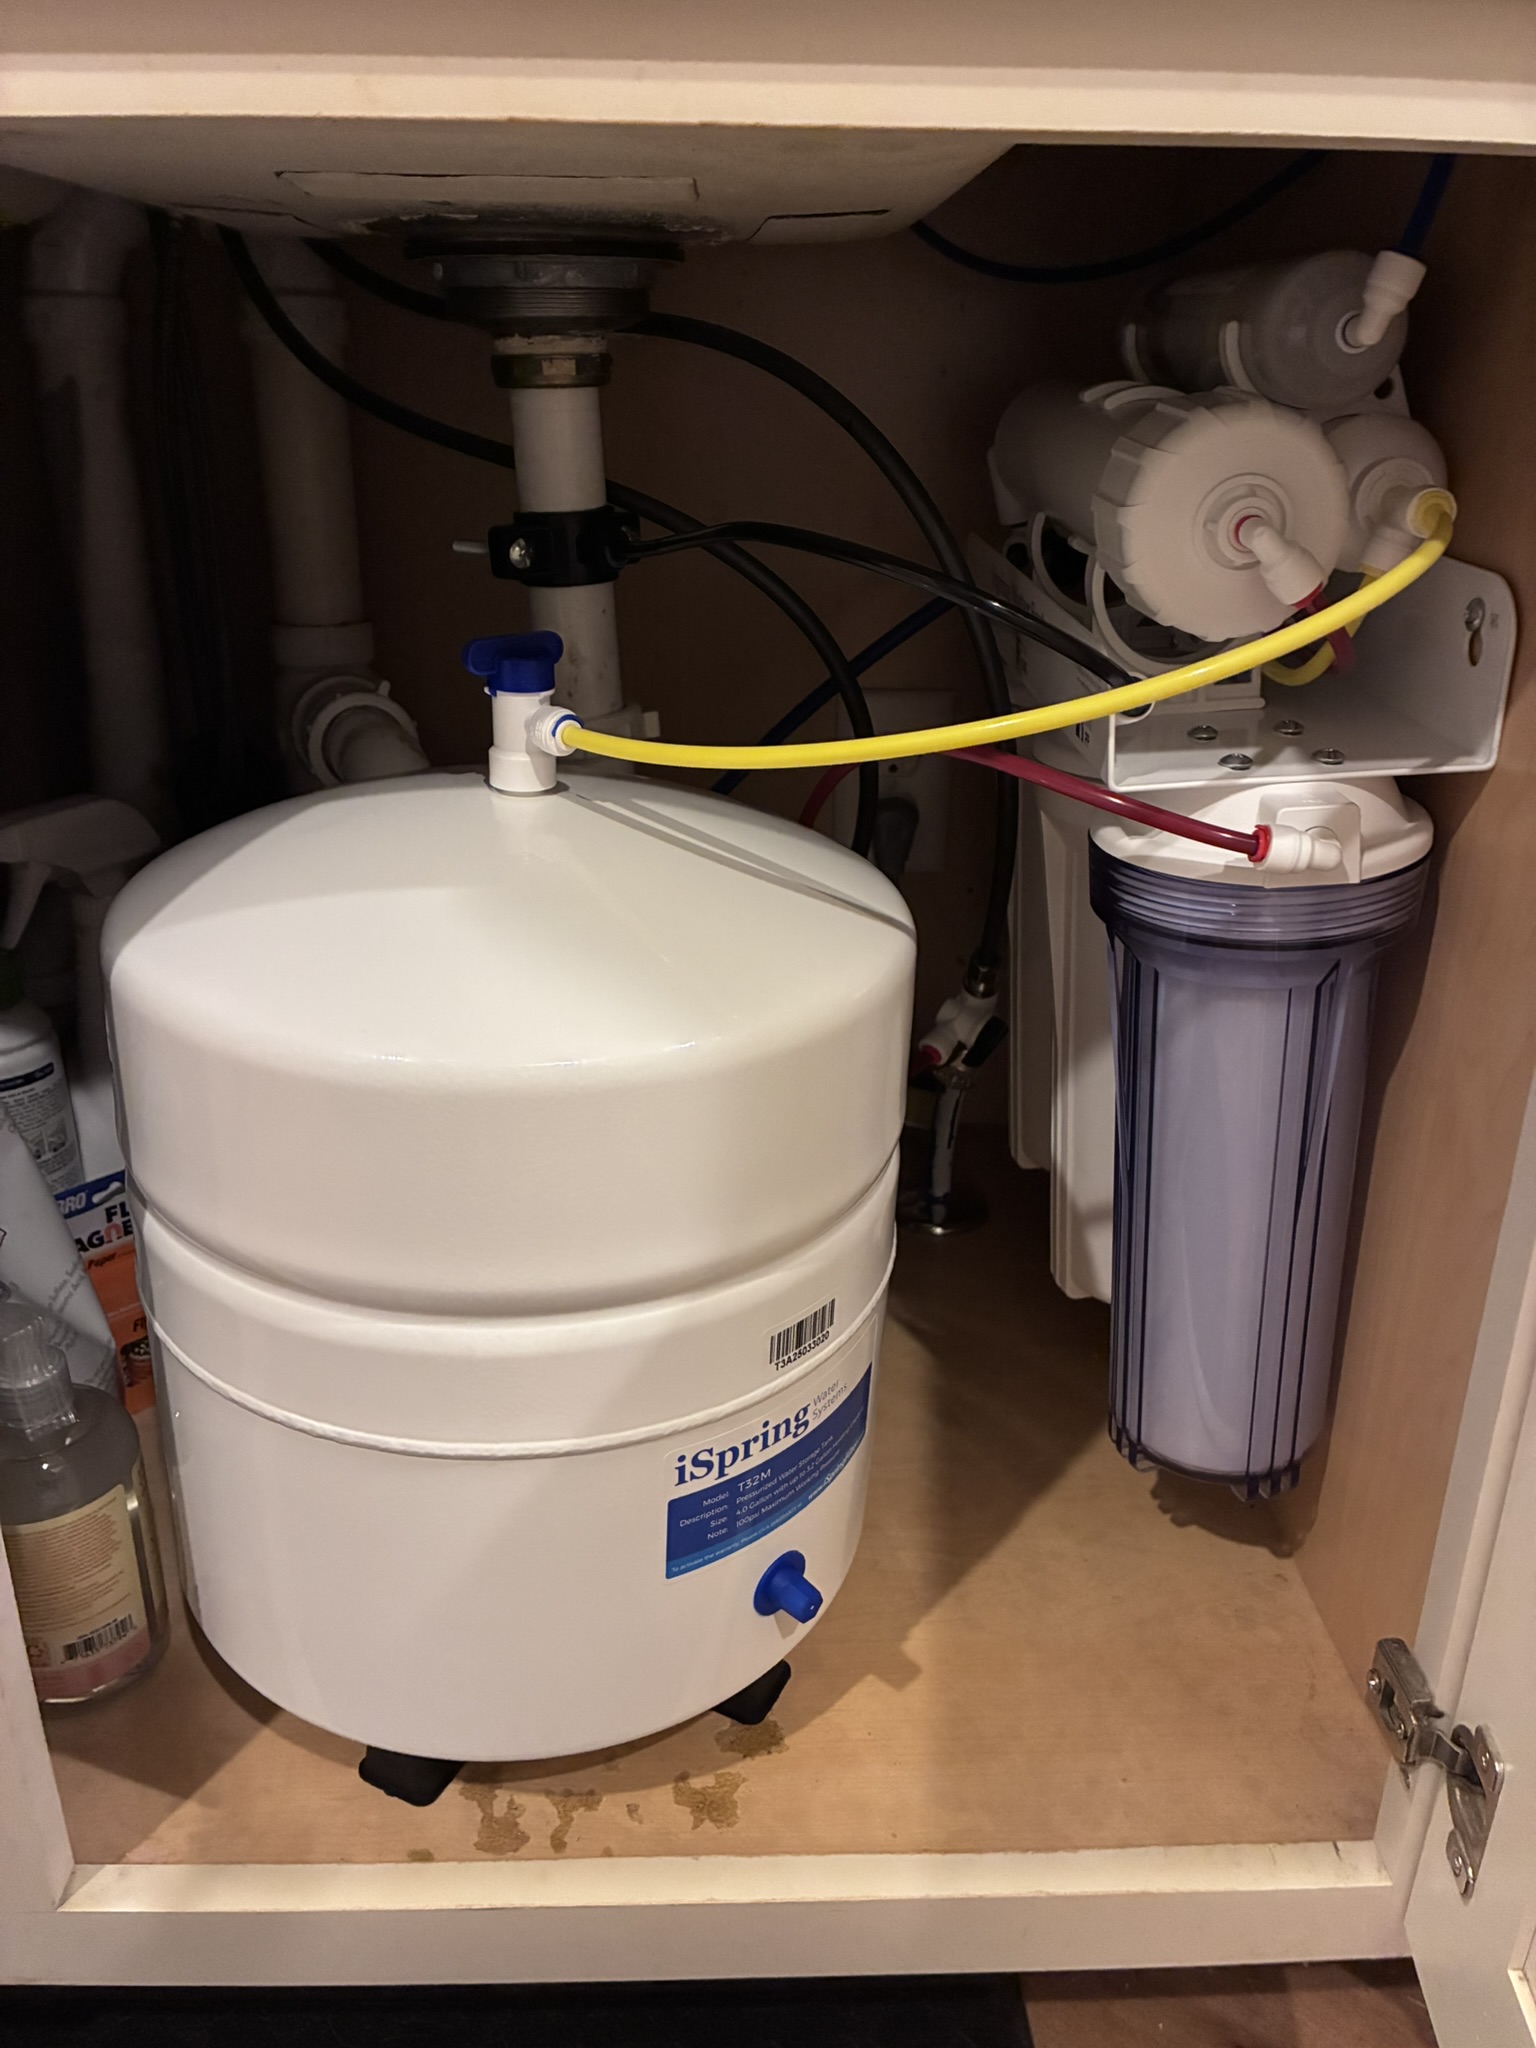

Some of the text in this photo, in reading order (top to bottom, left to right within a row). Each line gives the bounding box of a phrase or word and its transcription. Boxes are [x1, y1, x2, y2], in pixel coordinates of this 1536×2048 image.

[812, 1382, 847, 1420] Systems
[813, 1379, 839, 1407] Water
[675, 1403, 811, 1486] iSpring
[736, 1477, 778, 1504] Pressurized
[778, 1466, 797, 1481] Water
[737, 1468, 771, 1492] T32M
[735, 1506, 748, 1515] 4.0
[749, 1493, 772, 1509] Gallon
[773, 1482, 789, 1496] with
[761, 1489, 795, 1514] Maximum
